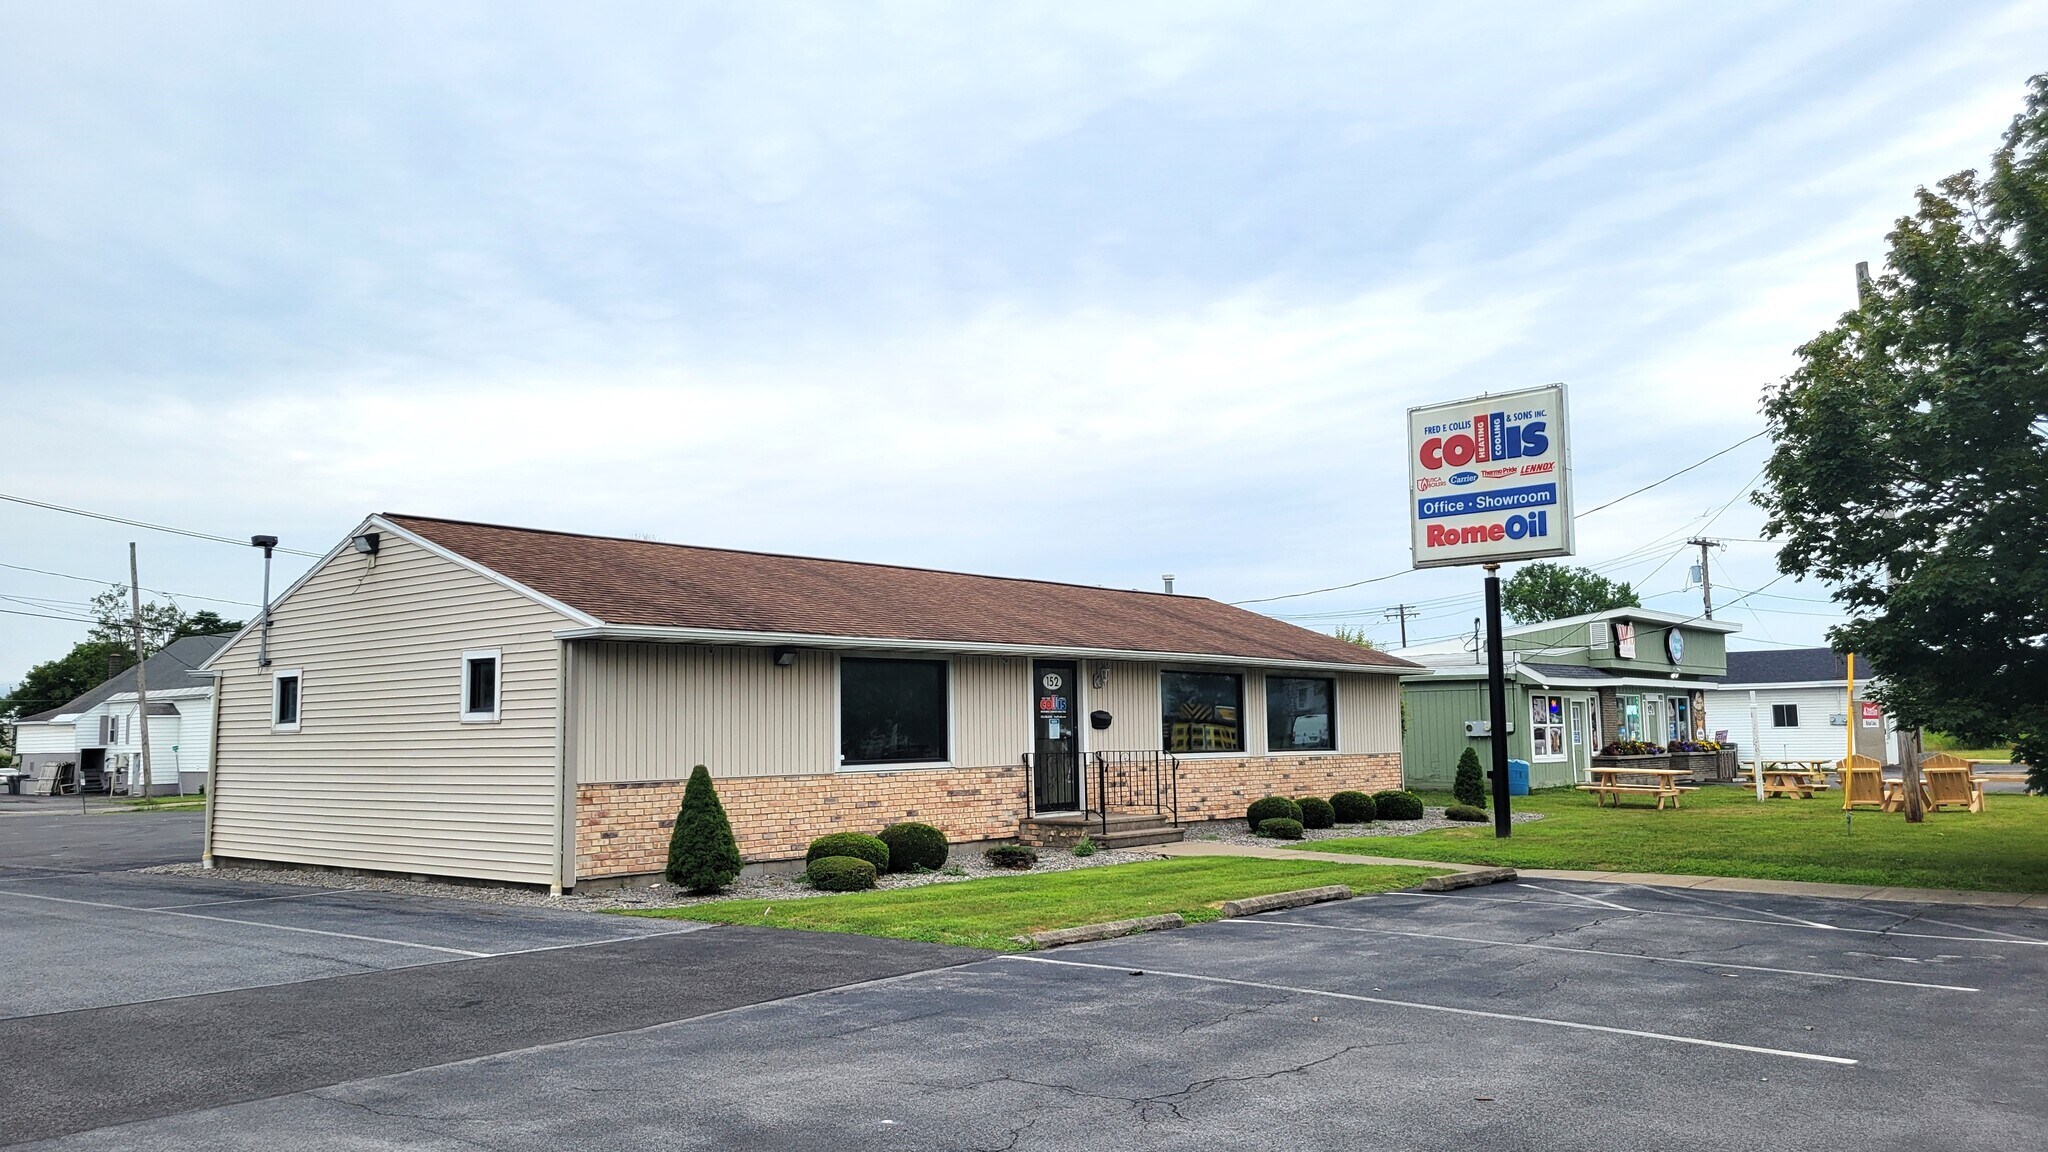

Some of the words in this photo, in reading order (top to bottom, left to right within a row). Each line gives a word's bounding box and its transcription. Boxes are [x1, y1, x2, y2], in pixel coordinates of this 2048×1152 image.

[1424, 425, 1441, 435] FRED
[1448, 420, 1472, 431] COLLIS
[1506, 414, 1512, 422] &
[1513, 410, 1533, 421] SONS
[1478, 421, 1486, 458] HEATING
[1521, 461, 1555, 473] LENNOX
[1450, 474, 1477, 485] Carrier
[1423, 500, 1465, 515] Office
[1476, 489, 1550, 509] Showroom
[1046, 676, 1059, 687] 152
